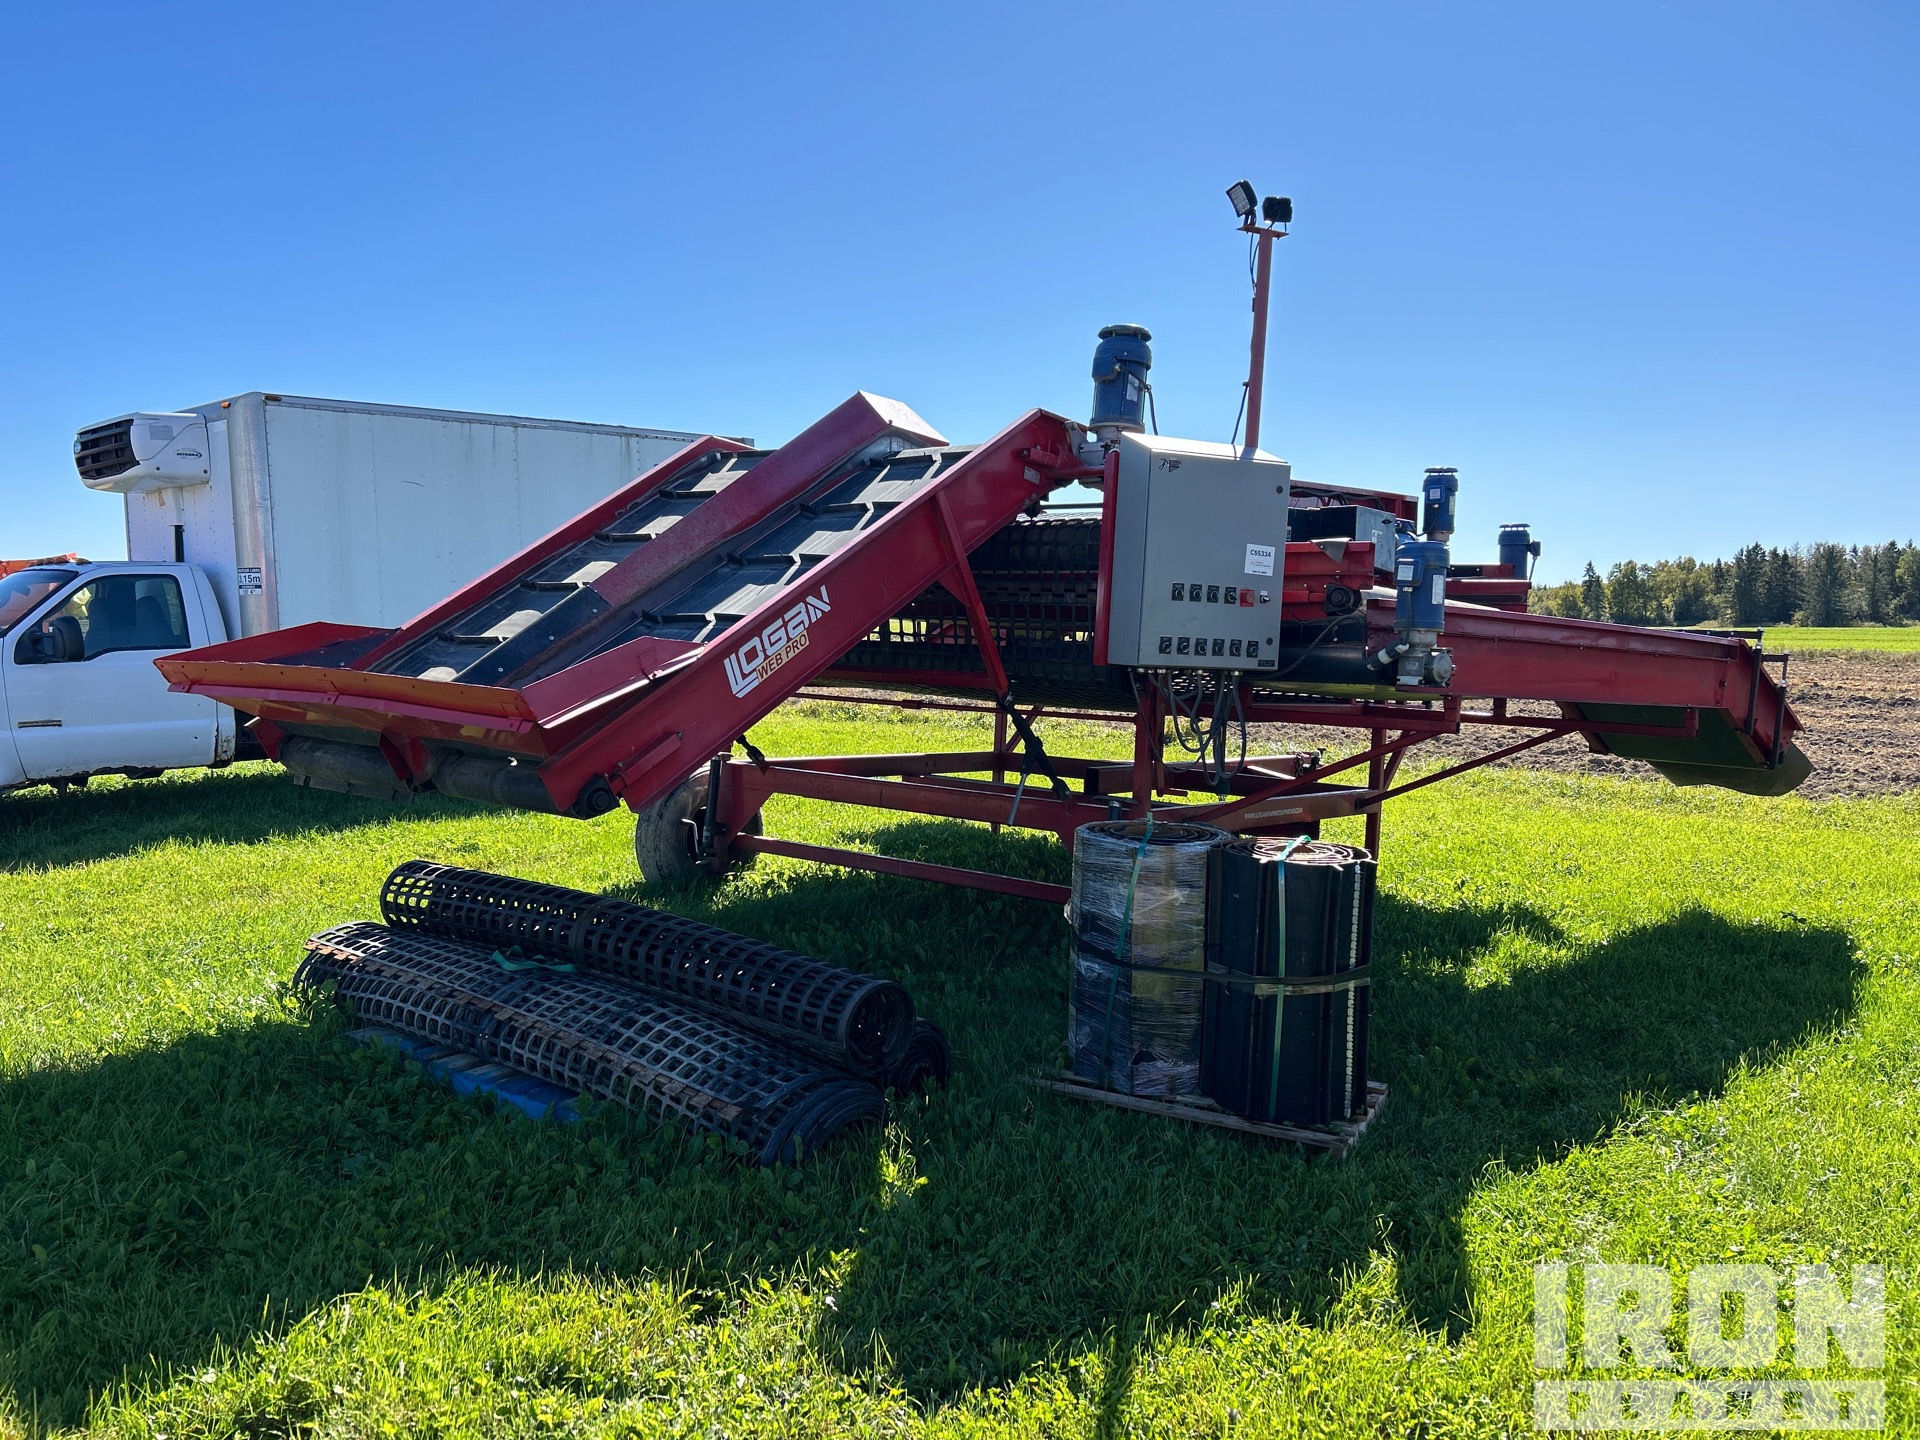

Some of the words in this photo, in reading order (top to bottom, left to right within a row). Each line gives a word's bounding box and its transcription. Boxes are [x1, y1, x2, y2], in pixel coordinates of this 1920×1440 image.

[1250, 549, 1272, 558] C55334
[757, 652, 784, 680] WEB
[785, 633, 808, 659] PRO
